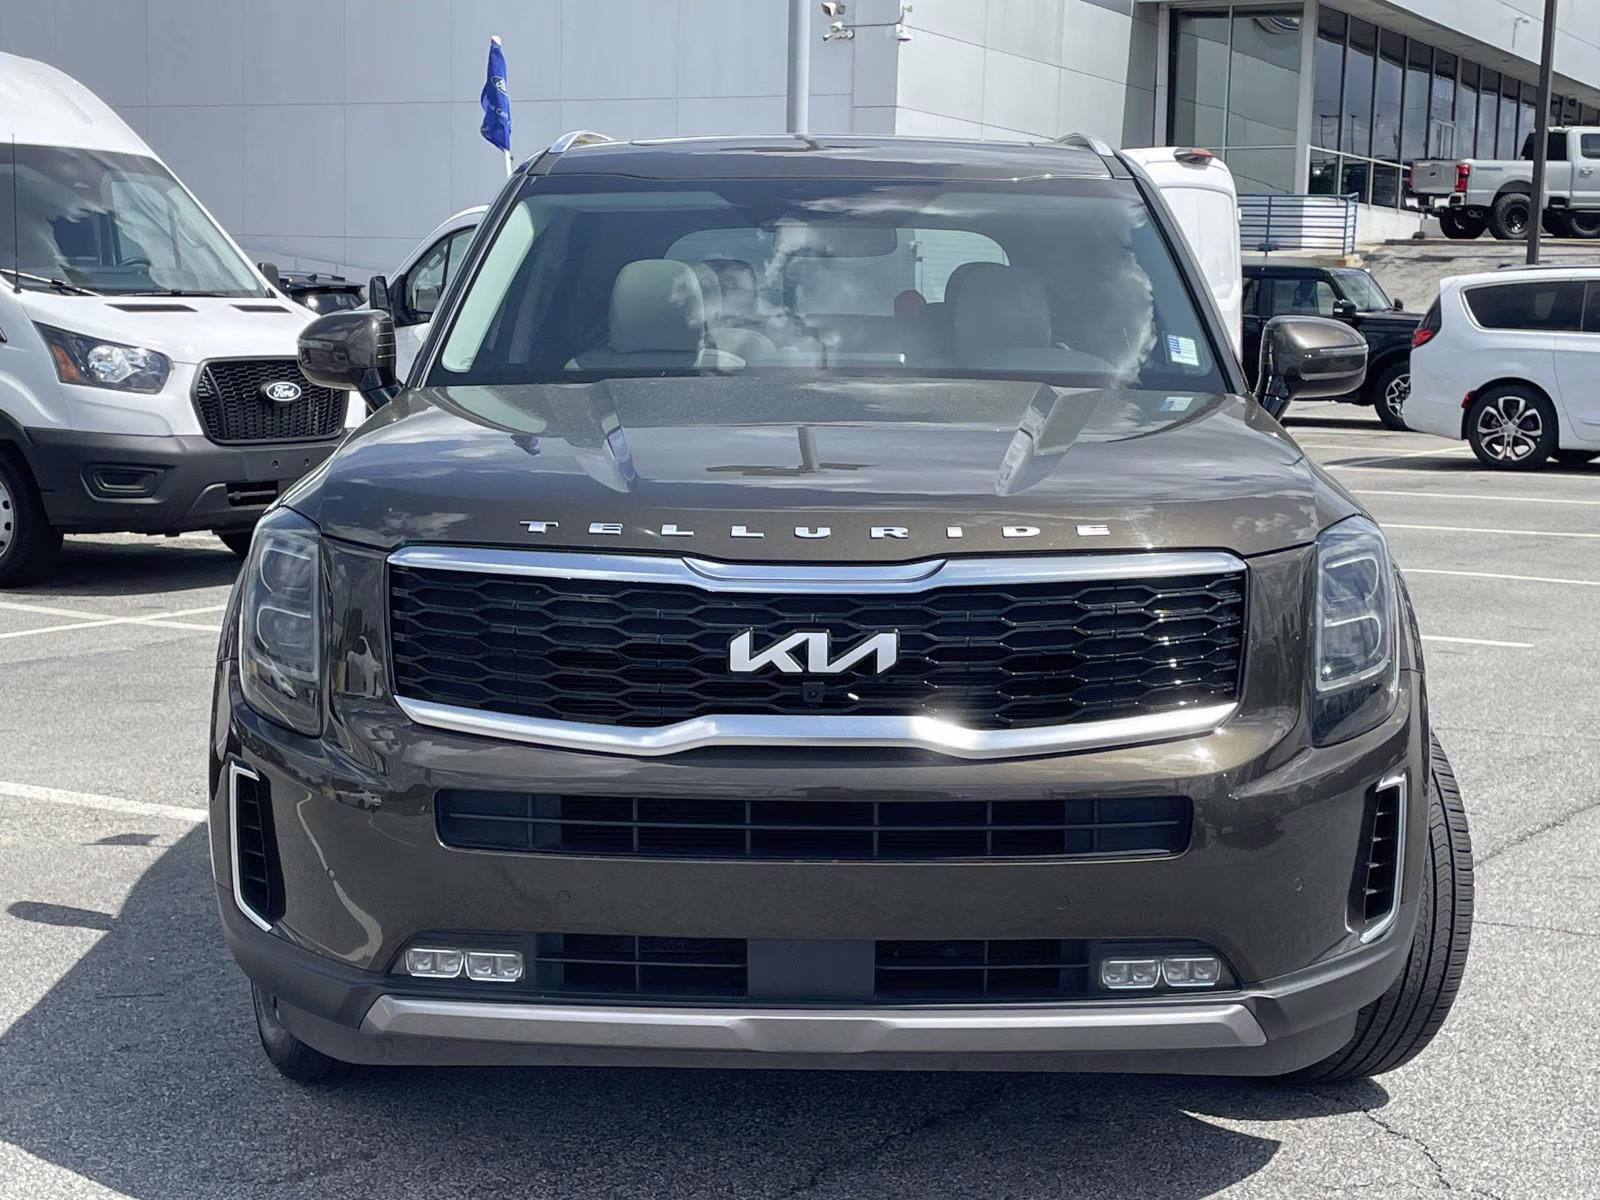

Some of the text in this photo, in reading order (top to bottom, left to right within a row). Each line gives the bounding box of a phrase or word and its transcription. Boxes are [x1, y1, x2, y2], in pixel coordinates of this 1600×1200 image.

[273, 384, 295, 398] Ford
[519, 520, 1111, 539] TELLURIDE
[729, 630, 898, 674] KIA
